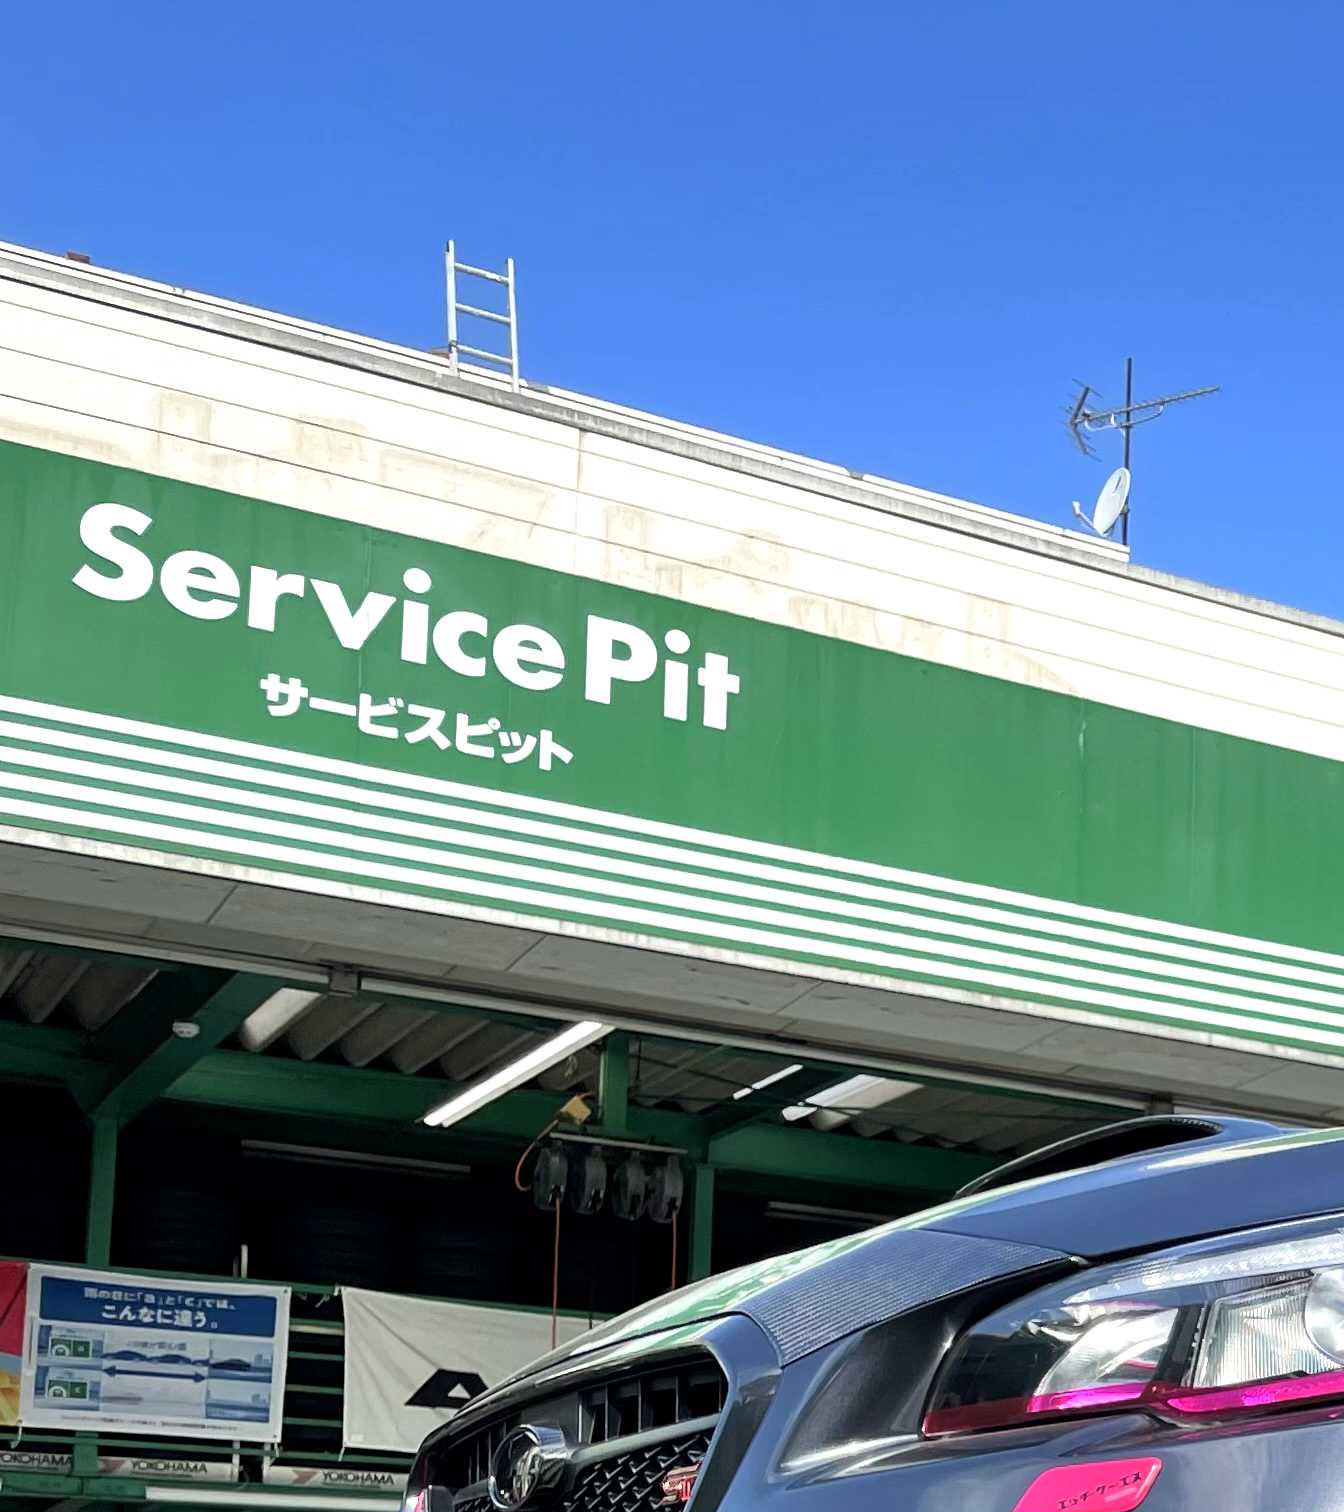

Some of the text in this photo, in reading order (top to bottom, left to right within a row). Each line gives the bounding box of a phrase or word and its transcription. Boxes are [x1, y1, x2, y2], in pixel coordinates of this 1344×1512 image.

[72, 501, 741, 731] Service Pit
[259, 672, 574, 772] サービスピット
[131, 1459, 208, 1474] YOKOHAMA
[322, 1471, 394, 1485] YOKOHAMA
